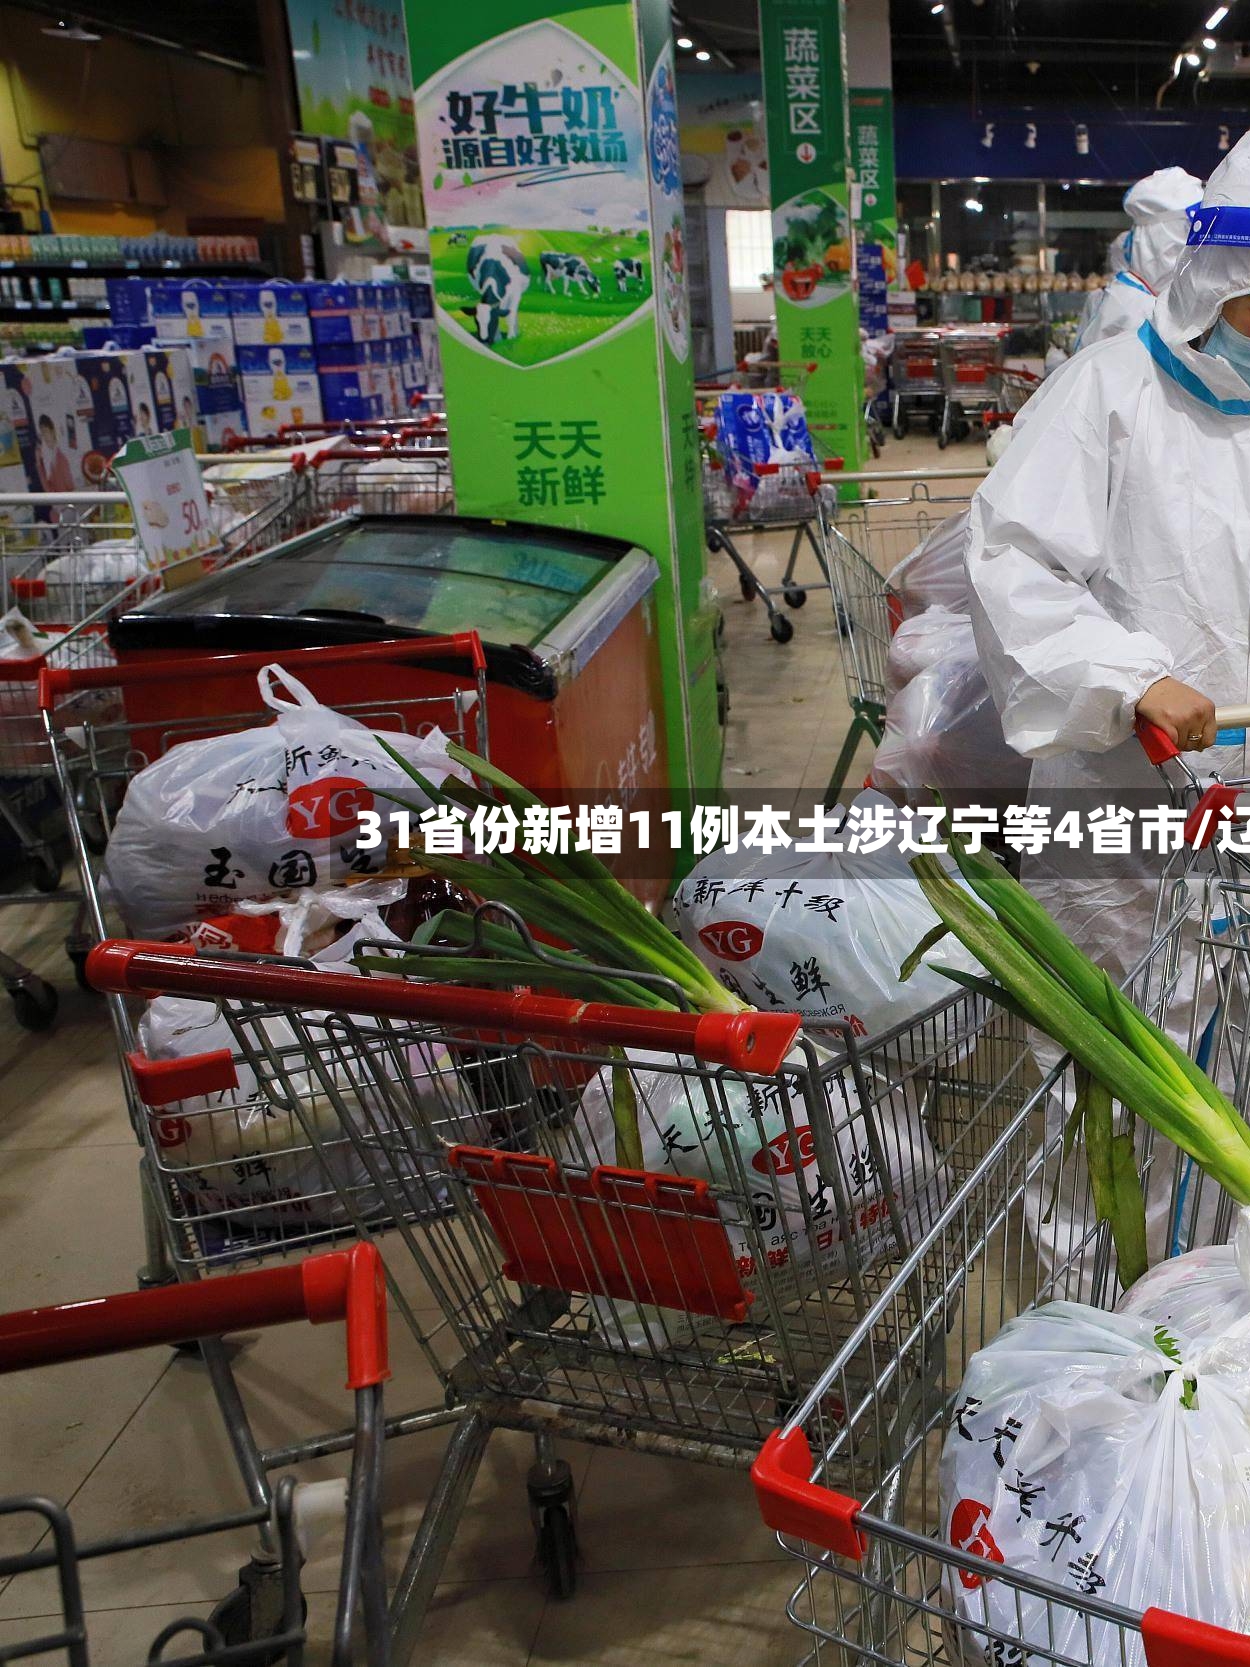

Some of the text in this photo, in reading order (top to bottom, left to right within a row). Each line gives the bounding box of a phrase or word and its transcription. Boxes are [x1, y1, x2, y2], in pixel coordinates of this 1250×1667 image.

[783, 28, 821, 134] 蔬菜区
[445, 82, 620, 135] 好牛奶
[441, 131, 628, 169] 源自好牧场
[857, 125, 880, 189] 蔬菜区
[513, 421, 603, 460] 天天
[517, 465, 607, 507] 新鲜
[289, 788, 362, 831] YG
[703, 928, 752, 955] YG
